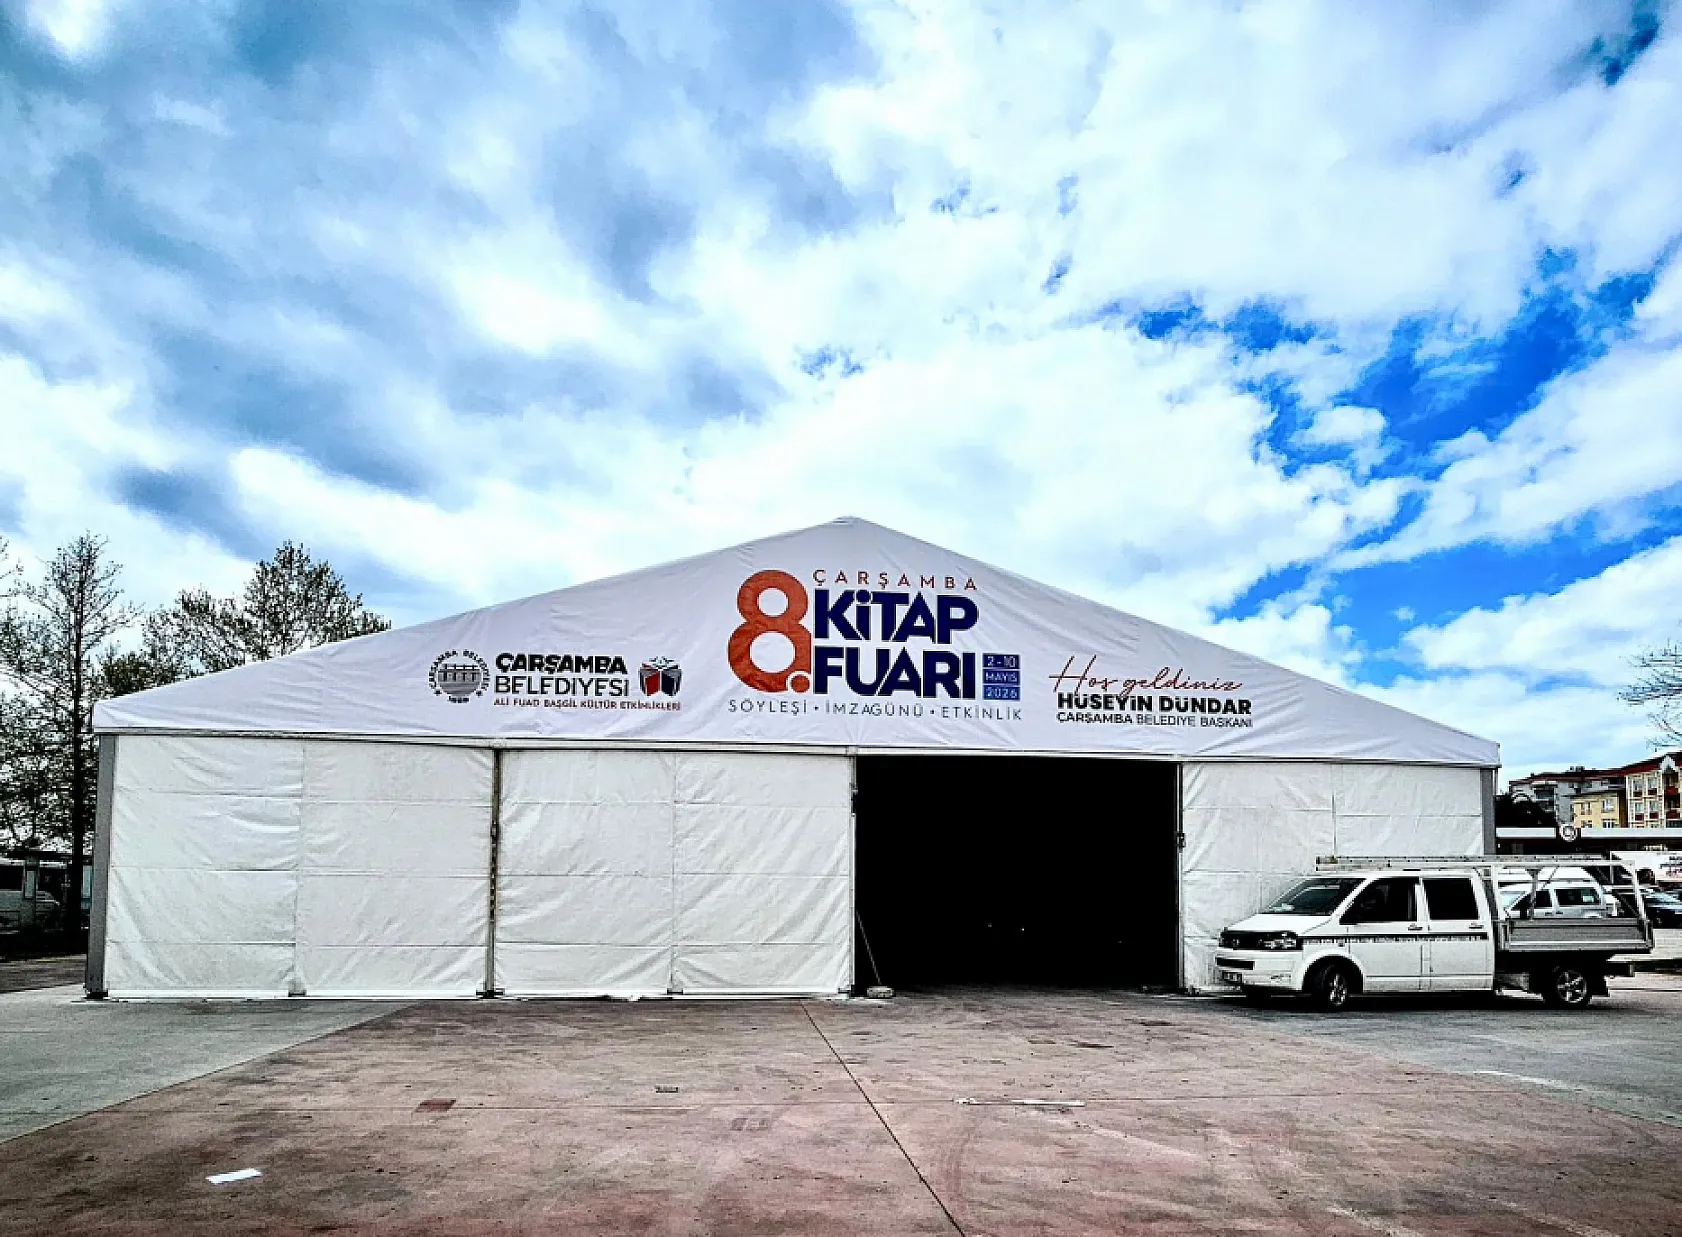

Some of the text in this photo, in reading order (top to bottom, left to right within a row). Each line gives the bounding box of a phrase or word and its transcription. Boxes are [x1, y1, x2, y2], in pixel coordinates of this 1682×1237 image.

[813, 569, 977, 591] ÇARŞAMBA
[495, 652, 628, 675] ÇARŞAMBA
[813, 645, 976, 700] FUARI
[1118, 666, 1243, 699] geldiniz
[493, 697, 510, 706] ALİ
[513, 699, 540, 708] FUAD
[580, 699, 618, 710] KÜLTÜR
[727, 699, 808, 717] SÖYLEŞİ
[941, 706, 1022, 721] ETKİNLİK
[1158, 695, 1252, 715] DÜNDAR
